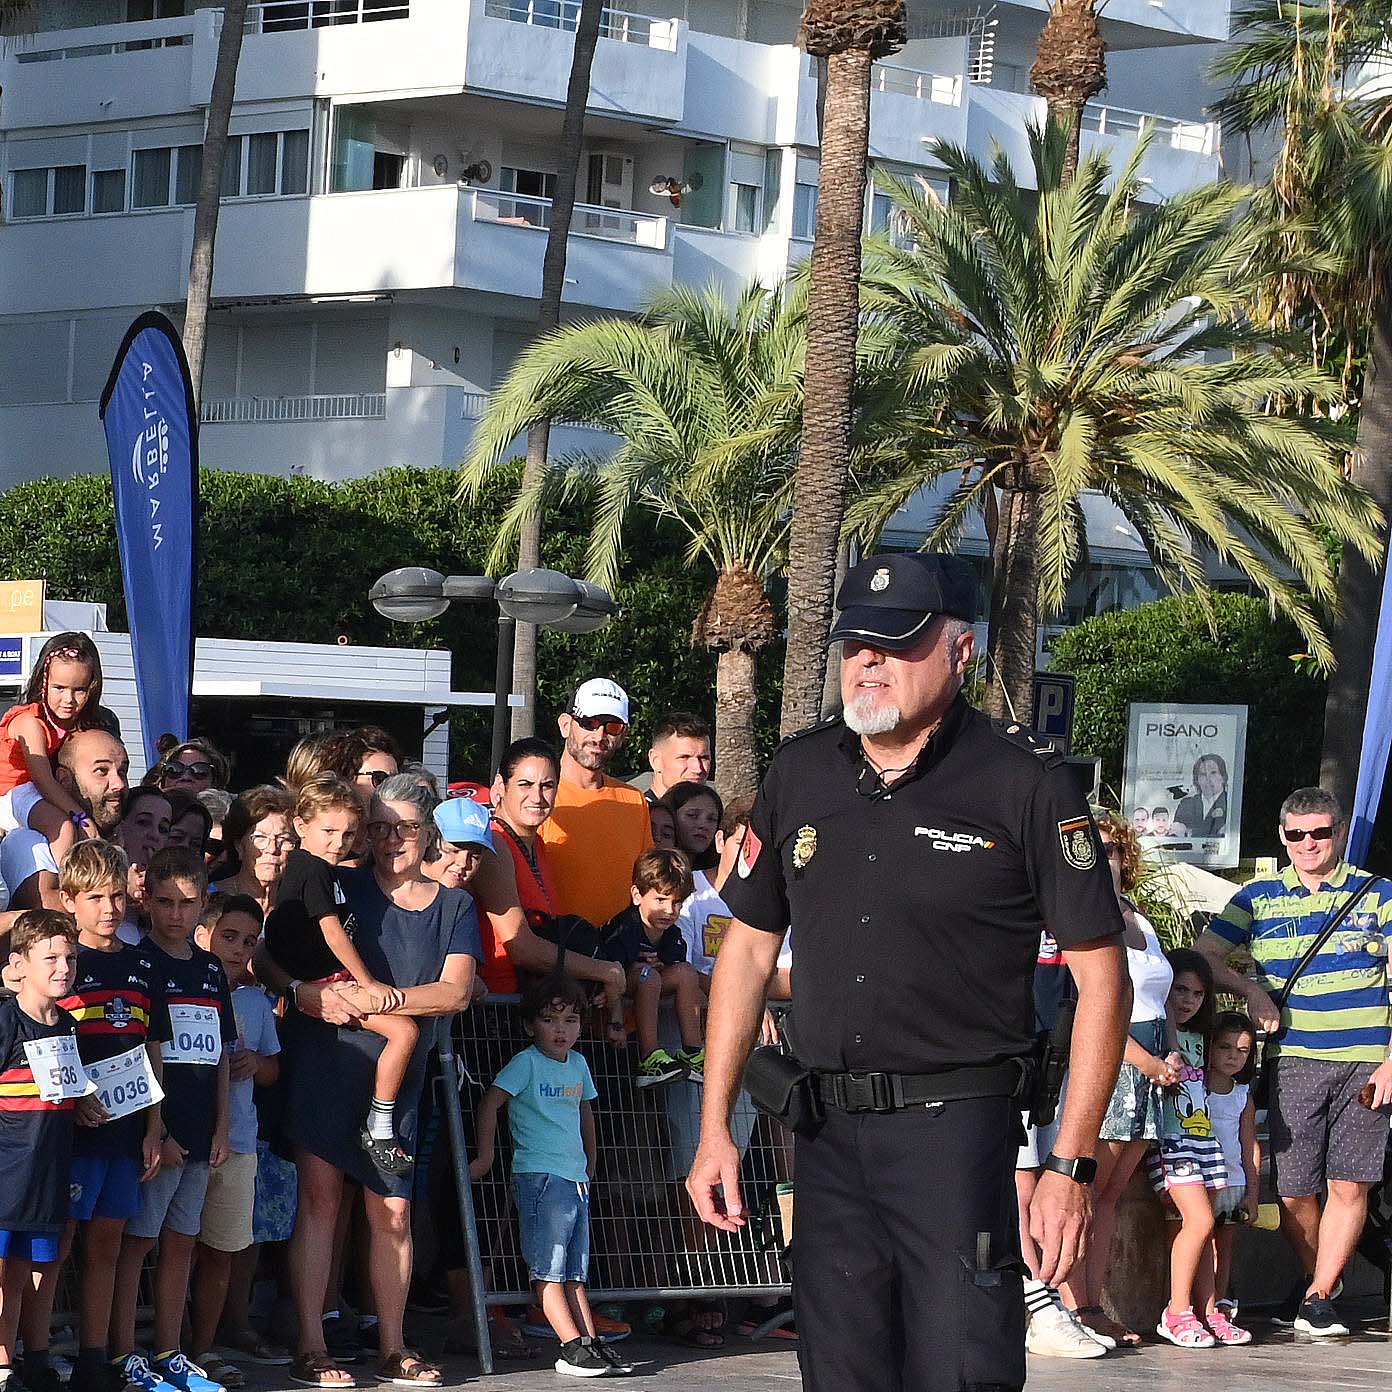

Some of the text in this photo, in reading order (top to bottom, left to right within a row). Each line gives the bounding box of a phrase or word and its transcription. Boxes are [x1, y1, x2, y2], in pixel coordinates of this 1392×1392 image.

[1038, 685, 1064, 733] P
[1146, 723, 1219, 738] PISANO
[914, 826, 984, 846] POLICIA
[932, 840, 972, 853] CNP
[169, 1032, 216, 1052] 1040
[49, 1065, 78, 1086] 536
[98, 1075, 150, 1110] 1036
